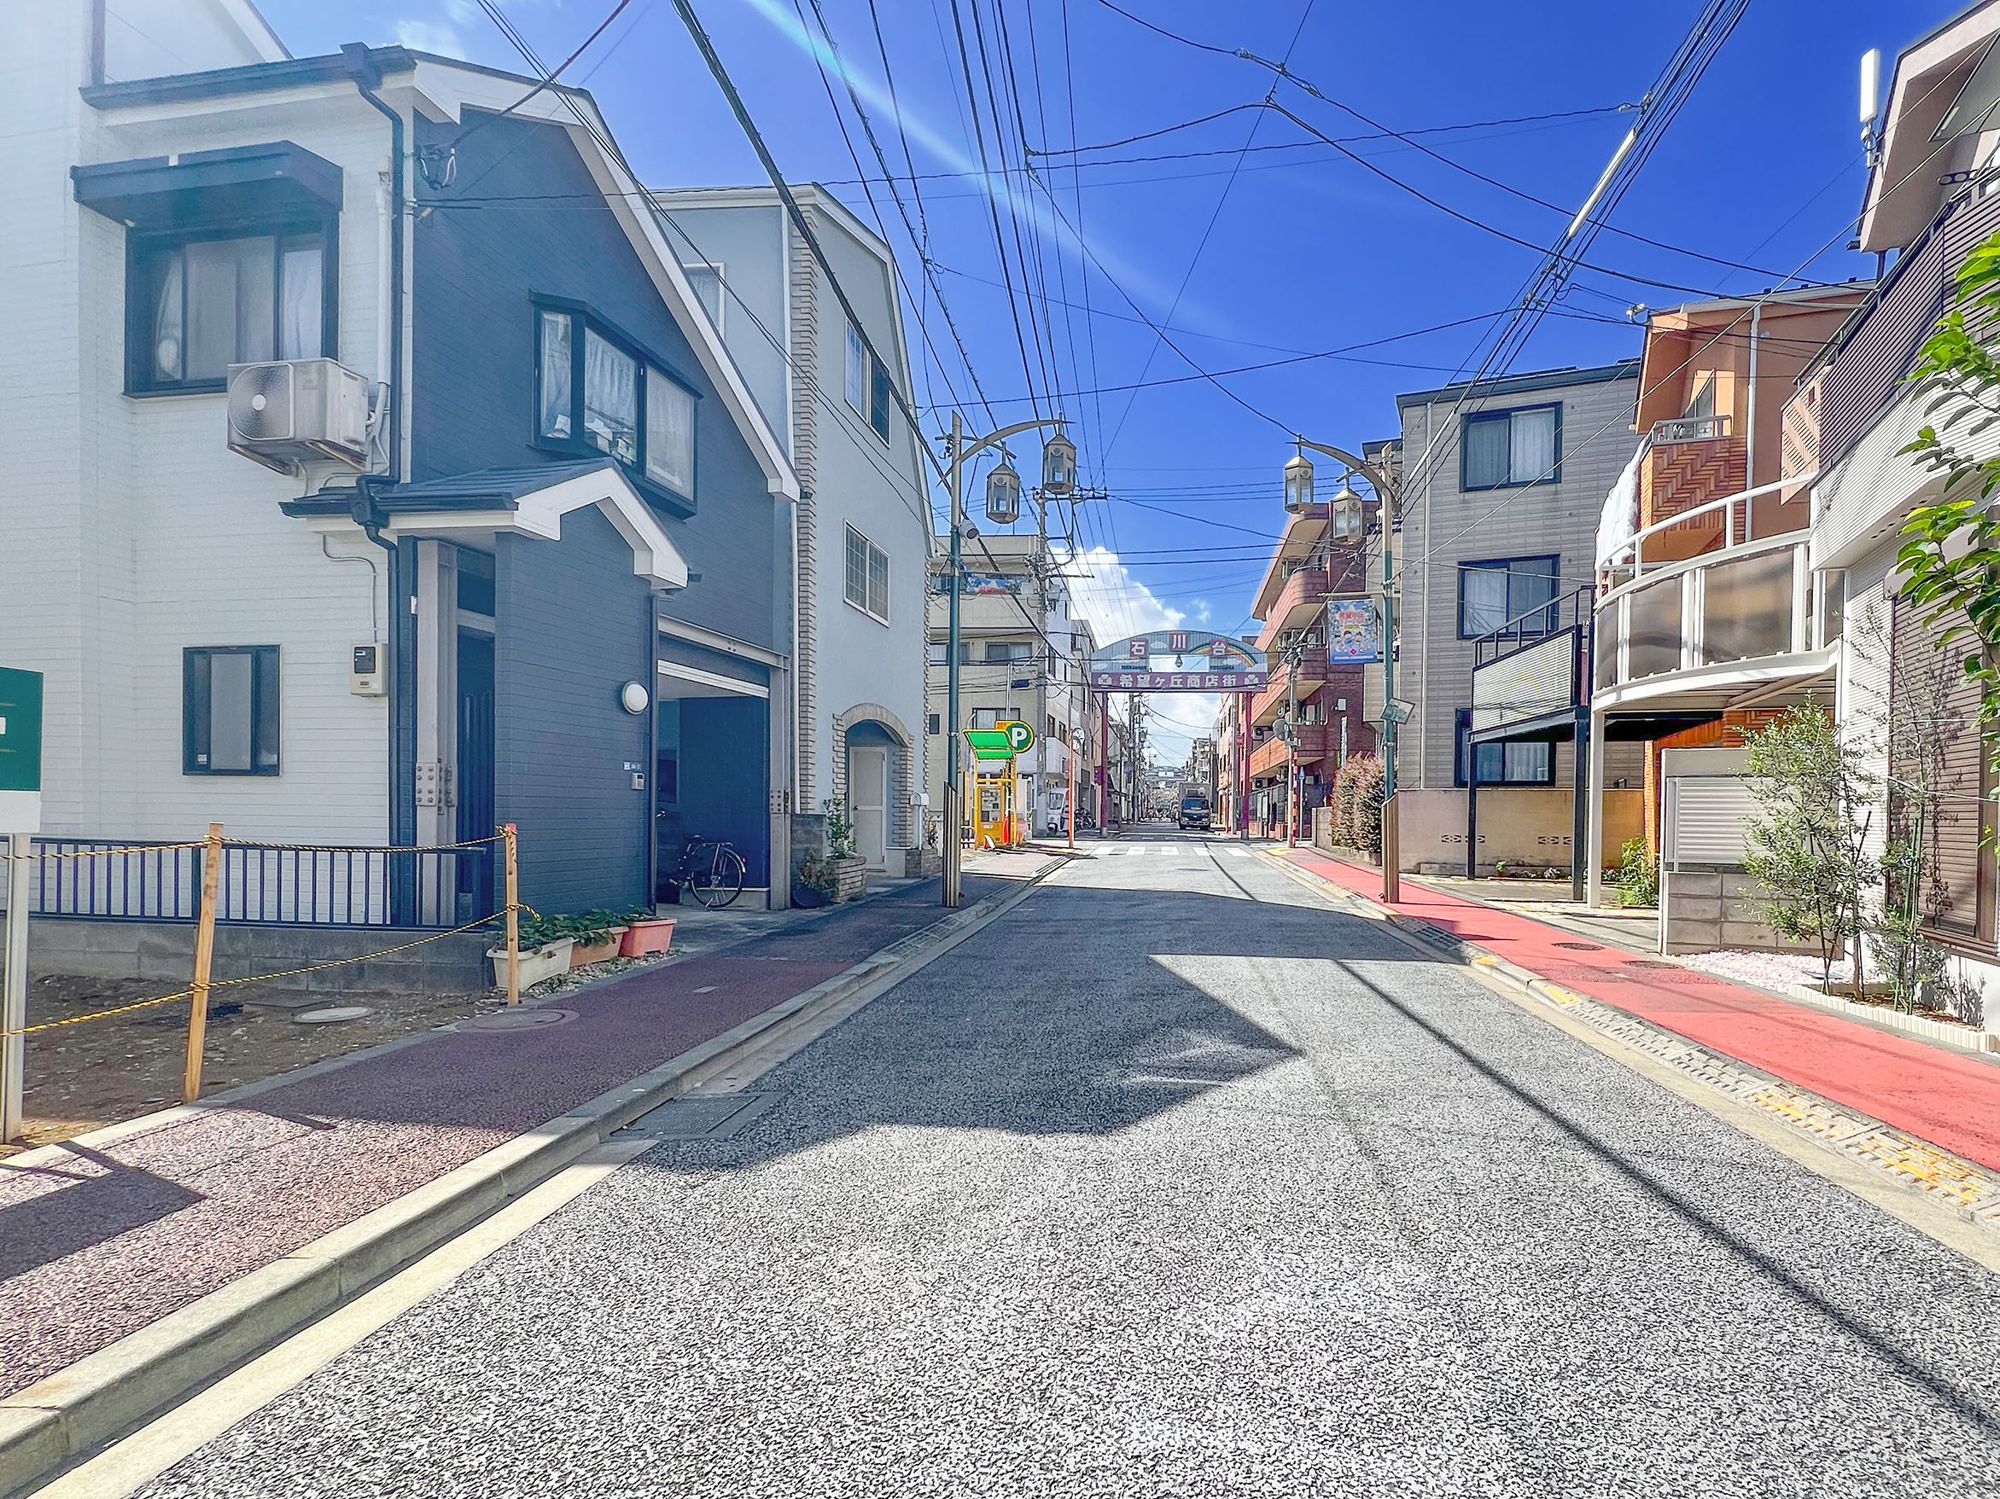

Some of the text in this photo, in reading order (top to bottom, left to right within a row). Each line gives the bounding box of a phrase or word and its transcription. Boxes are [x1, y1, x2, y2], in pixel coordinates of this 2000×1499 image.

[1131, 634, 1226, 655] 石川台
[1011, 727, 1028, 748] P
